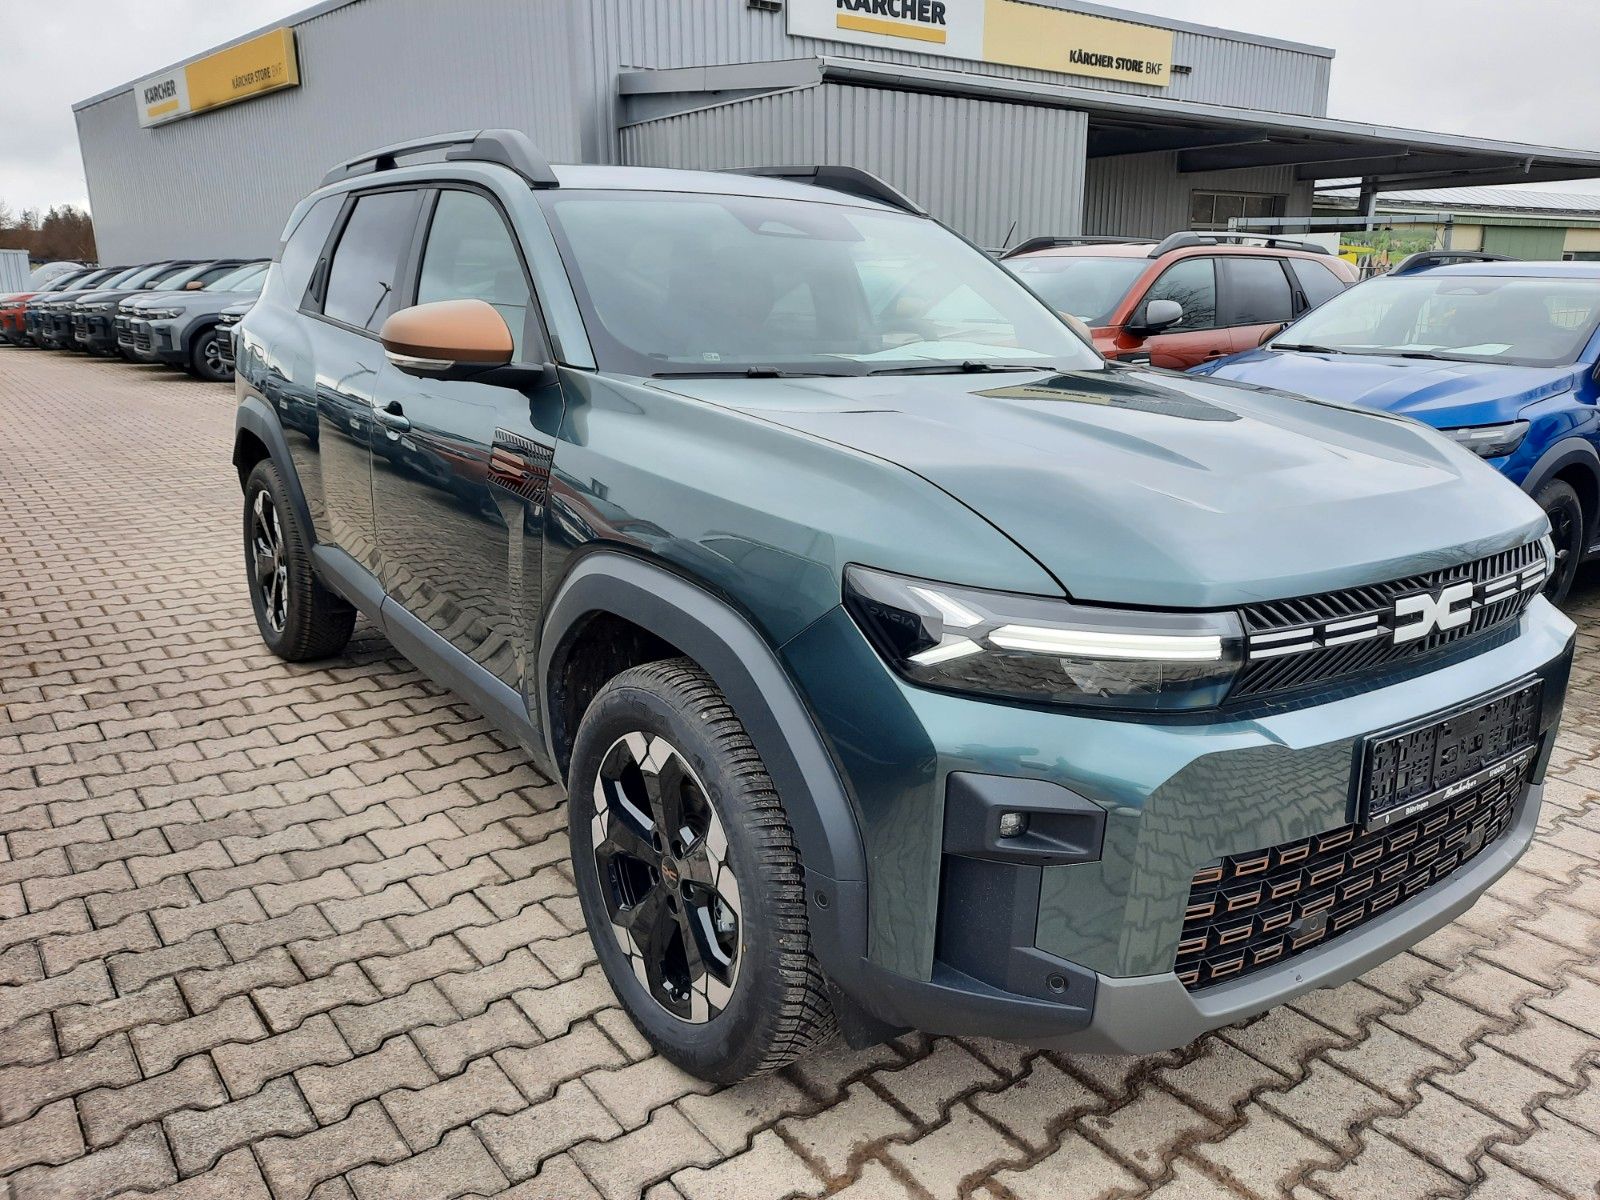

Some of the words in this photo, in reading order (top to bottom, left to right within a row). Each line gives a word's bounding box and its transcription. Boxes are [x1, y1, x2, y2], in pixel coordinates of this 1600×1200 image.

[1069, 49, 1114, 69] KÄRCHER
[1115, 57, 1144, 73] STORE
[1145, 61, 1163, 75] BKF
[255, 66, 271, 83] STORE
[869, 606, 916, 628] DACIA
